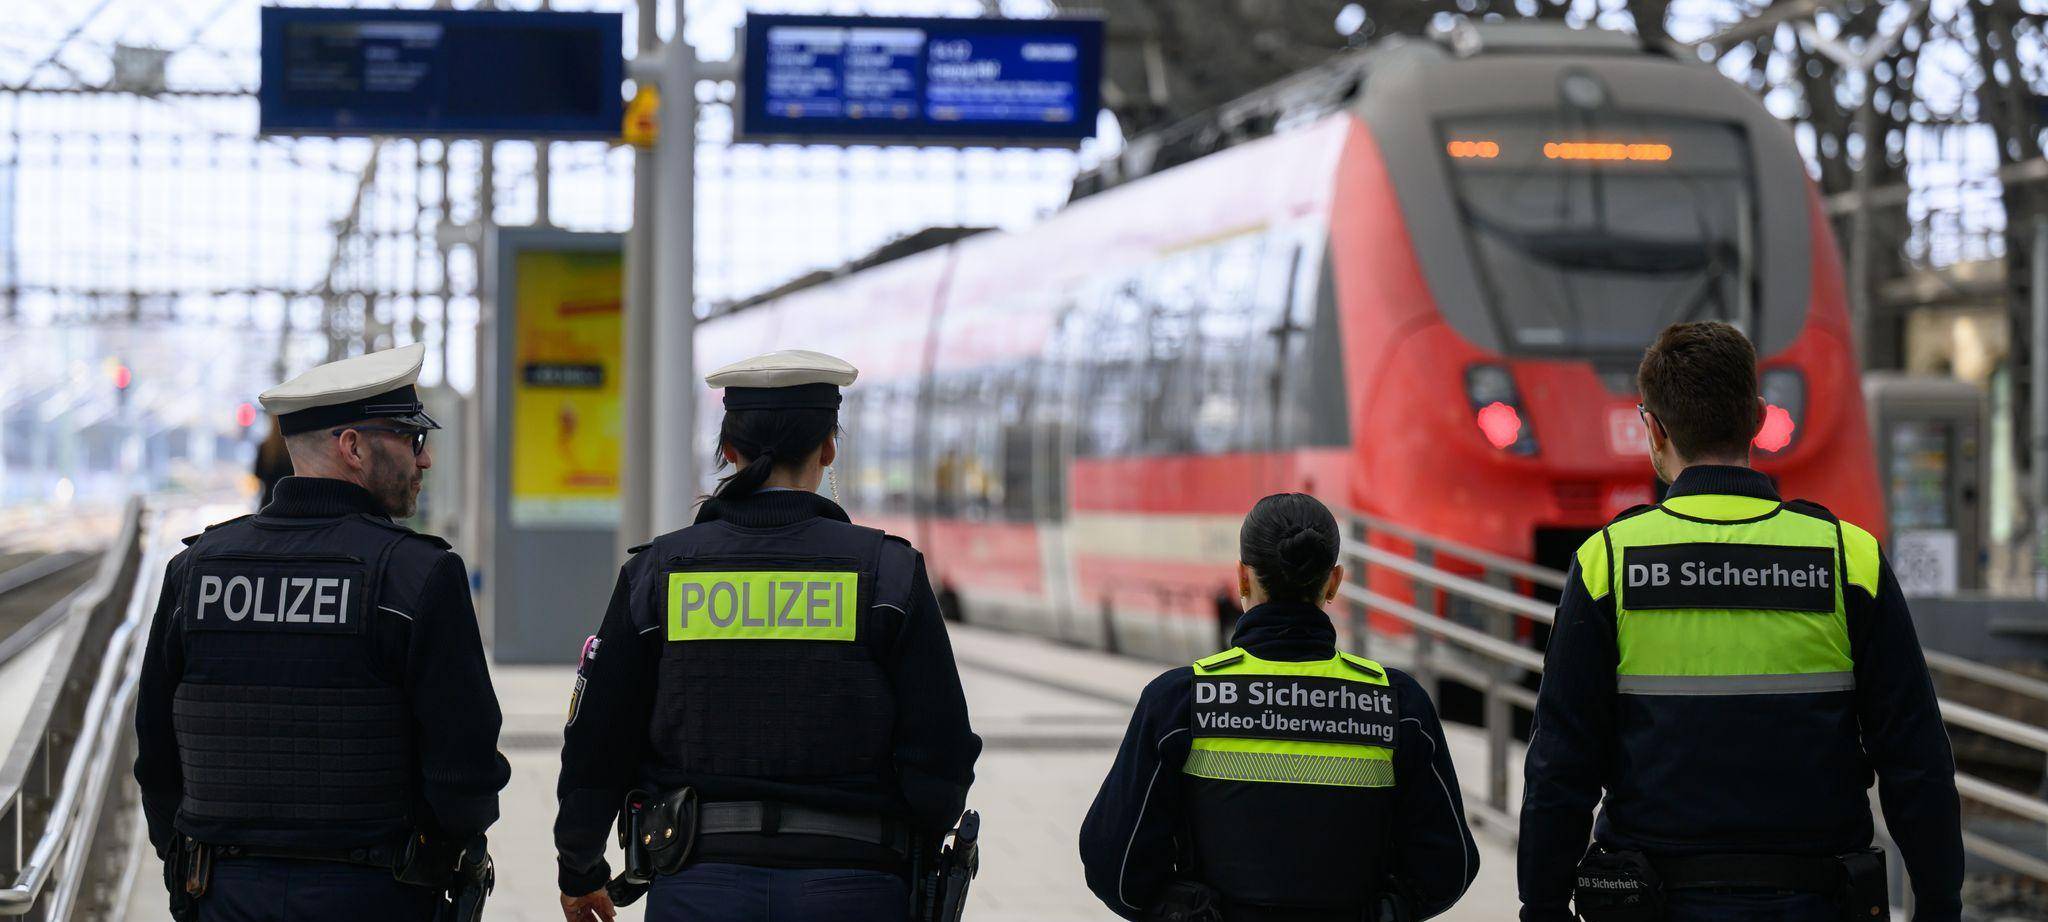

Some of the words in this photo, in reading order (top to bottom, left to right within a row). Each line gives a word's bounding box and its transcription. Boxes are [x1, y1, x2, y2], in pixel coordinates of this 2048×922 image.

[1628, 563, 1670, 587] DB
[1680, 561, 1829, 588] Sicherheit
[197, 575, 350, 624] POLIZEI
[681, 581, 843, 628] POLIZEI
[1195, 682, 1238, 704] DB
[1248, 682, 1393, 714] Sicherheit
[1196, 710, 1394, 742] Video-Überwachung
[1577, 877, 1591, 887] DB
[1592, 878, 1639, 889] Sicherheit
